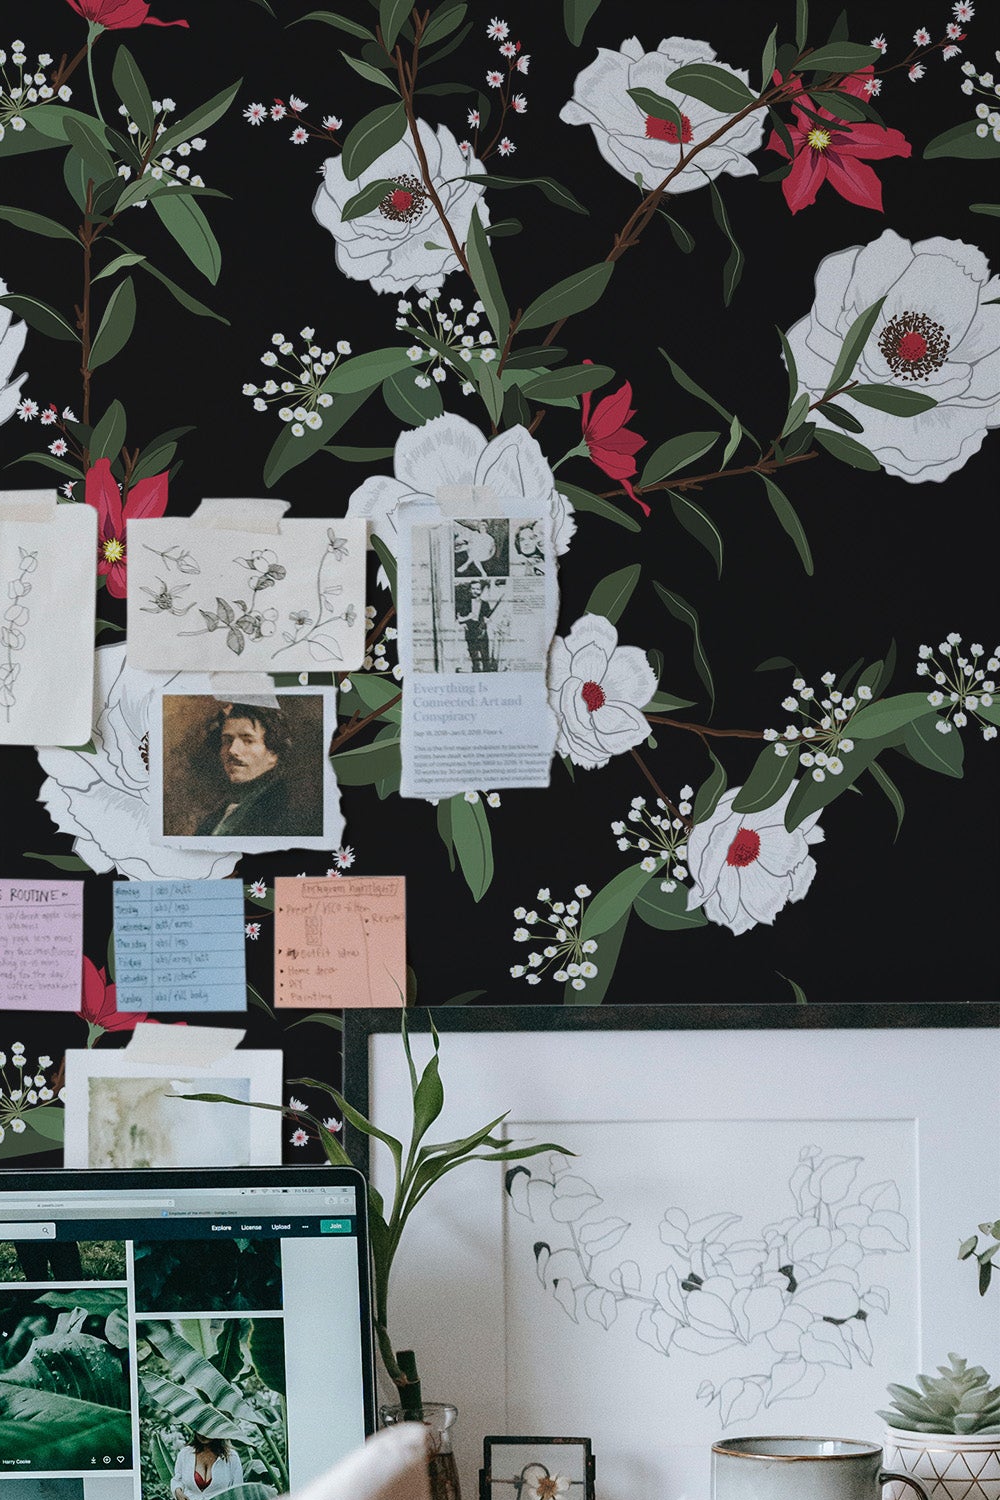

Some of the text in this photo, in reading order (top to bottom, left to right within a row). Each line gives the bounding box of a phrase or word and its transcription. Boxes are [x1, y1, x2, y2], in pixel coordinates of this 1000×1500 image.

[413, 682, 488, 696] Everything Is
[413, 695, 522, 708] Connected: Art and
[413, 711, 478, 724] Conspiracy
[10, 888, 59, 902] ROUTINE
[211, 1224, 232, 1232] Explore
[240, 1223, 262, 1231] License
[271, 1223, 291, 1231] Upload
